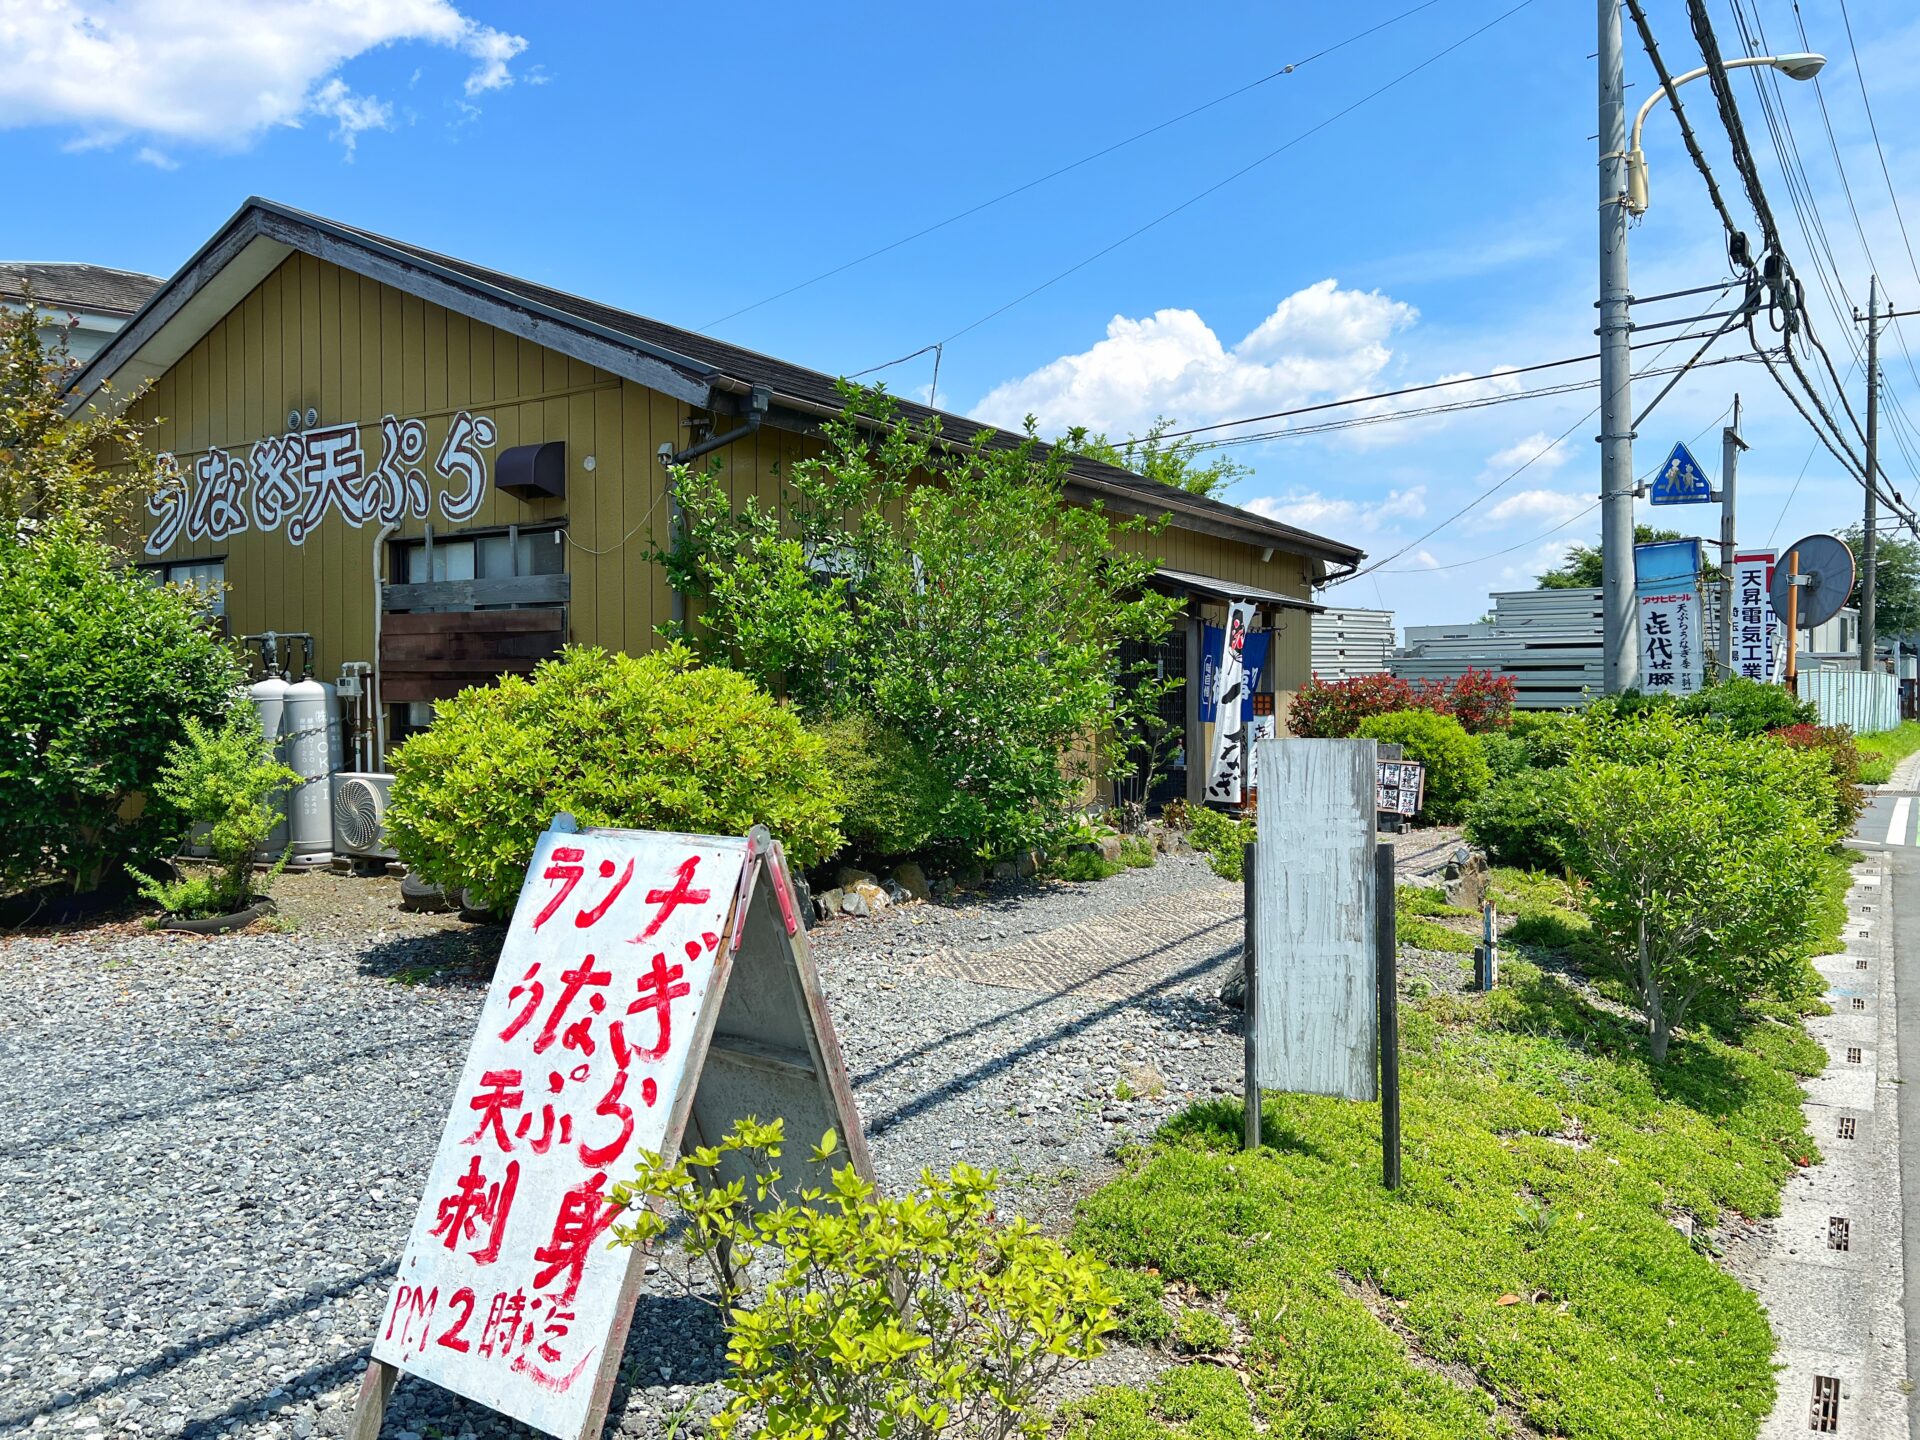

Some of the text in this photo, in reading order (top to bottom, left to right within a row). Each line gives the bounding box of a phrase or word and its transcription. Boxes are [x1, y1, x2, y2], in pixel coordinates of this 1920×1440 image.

[144, 411, 497, 555] うなぎ天ぷら
[1642, 594, 1691, 605] アサヒビール
[533, 846, 712, 945] ランチ
[498, 931, 720, 1064] うなぎ
[459, 1012, 659, 1169] 天ぷら
[428, 1154, 622, 1306] 刺身
